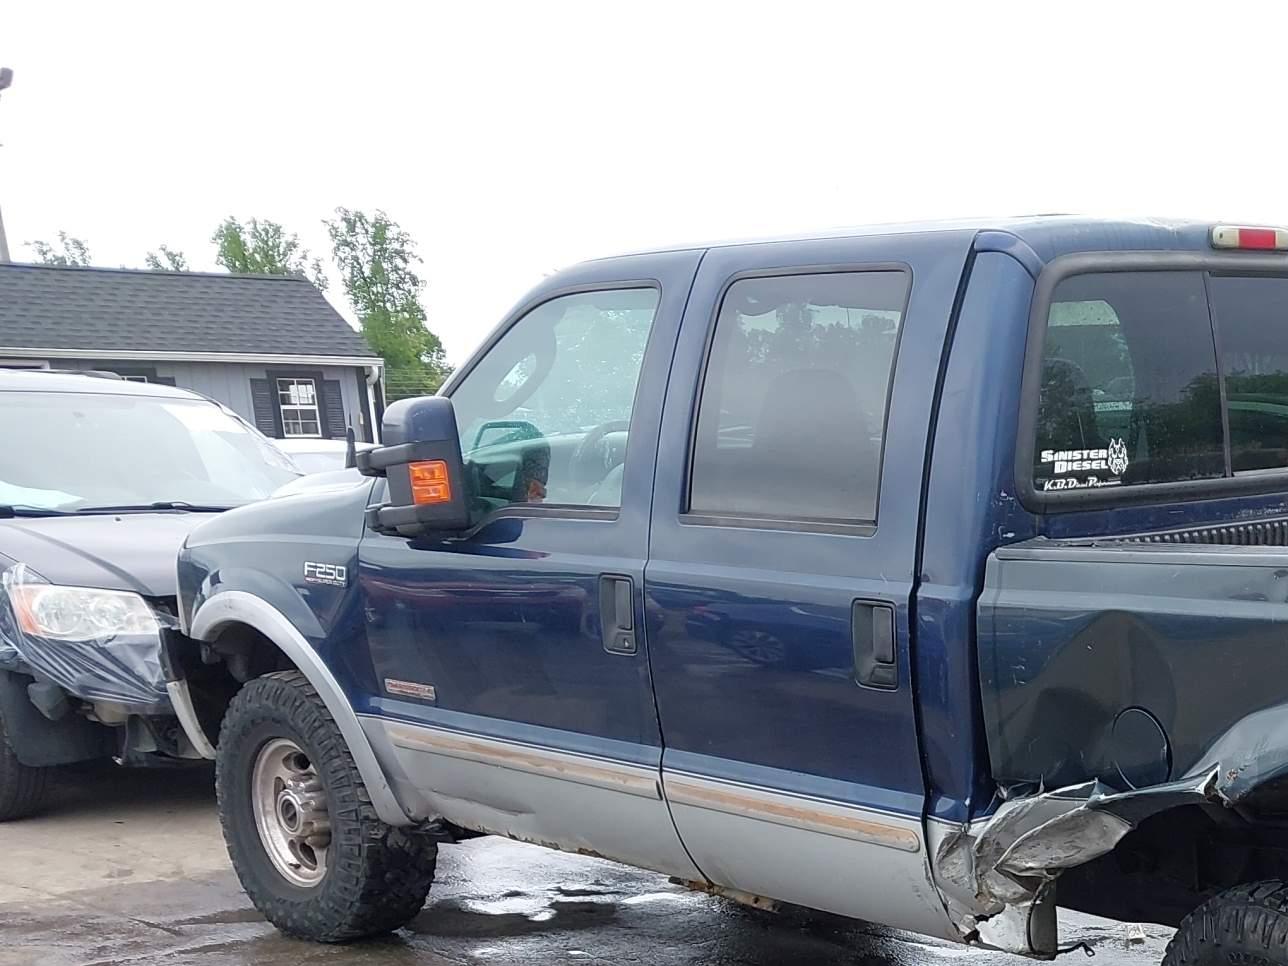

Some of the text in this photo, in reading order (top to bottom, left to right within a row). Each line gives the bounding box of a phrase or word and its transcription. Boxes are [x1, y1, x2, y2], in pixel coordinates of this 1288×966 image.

[1041, 449, 1107, 463] SINISTER
[1054, 460, 1108, 474] DIESEL
[304, 561, 346, 581] F250
